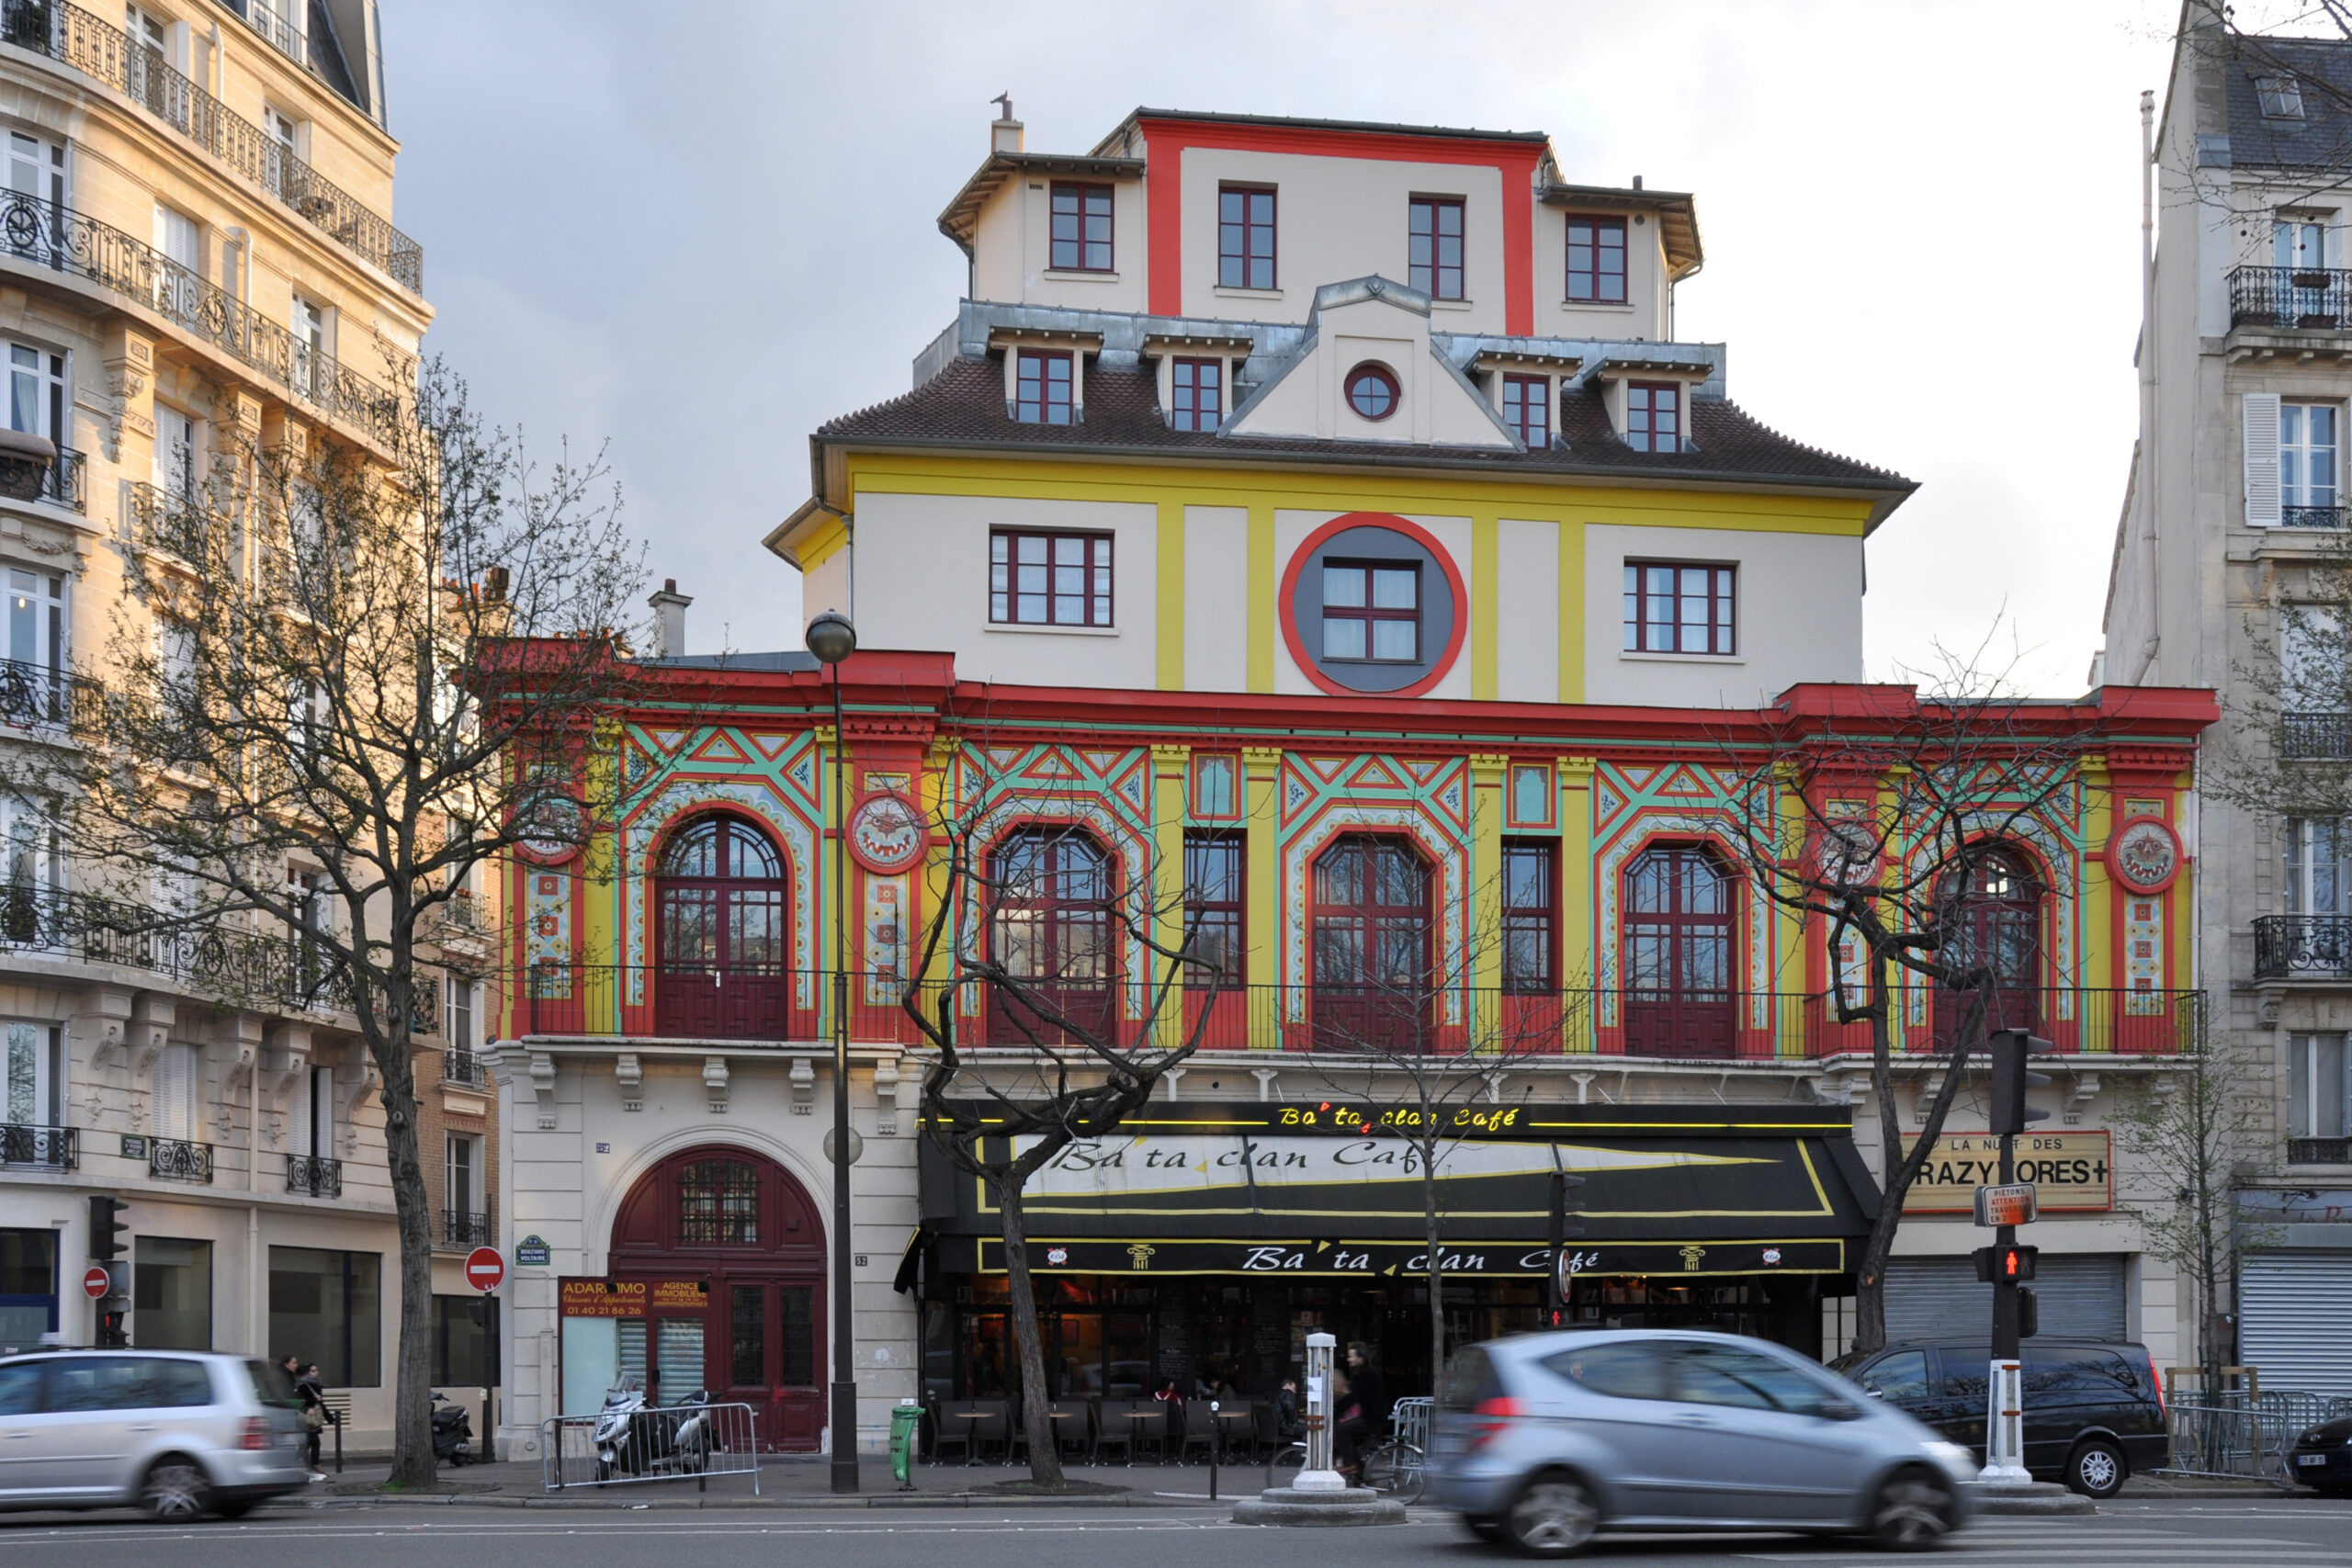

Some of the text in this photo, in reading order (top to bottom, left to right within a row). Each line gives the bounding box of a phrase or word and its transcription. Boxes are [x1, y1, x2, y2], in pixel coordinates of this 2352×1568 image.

[1277, 1107, 1317, 1125] Ba
[1334, 1106, 1362, 1125] ta
[1453, 1107, 1520, 1132] Café
[1951, 1138, 2063, 1150] LA NUT DES
[1048, 1142, 1123, 1171] Ba
[1146, 1148, 1186, 1168] ta
[1216, 1142, 1307, 1168] clan
[1915, 1159, 2108, 1185] RAZYORES+
[1991, 1196, 2030, 1205] ATTENTION
[856, 1257, 866, 1265] 52
[1242, 1247, 1600, 1273] Ba ta clan Cfé
[562, 1282, 646, 1294] ADARIMO
[567, 1306, 641, 1314] 01 40 21 86 26
